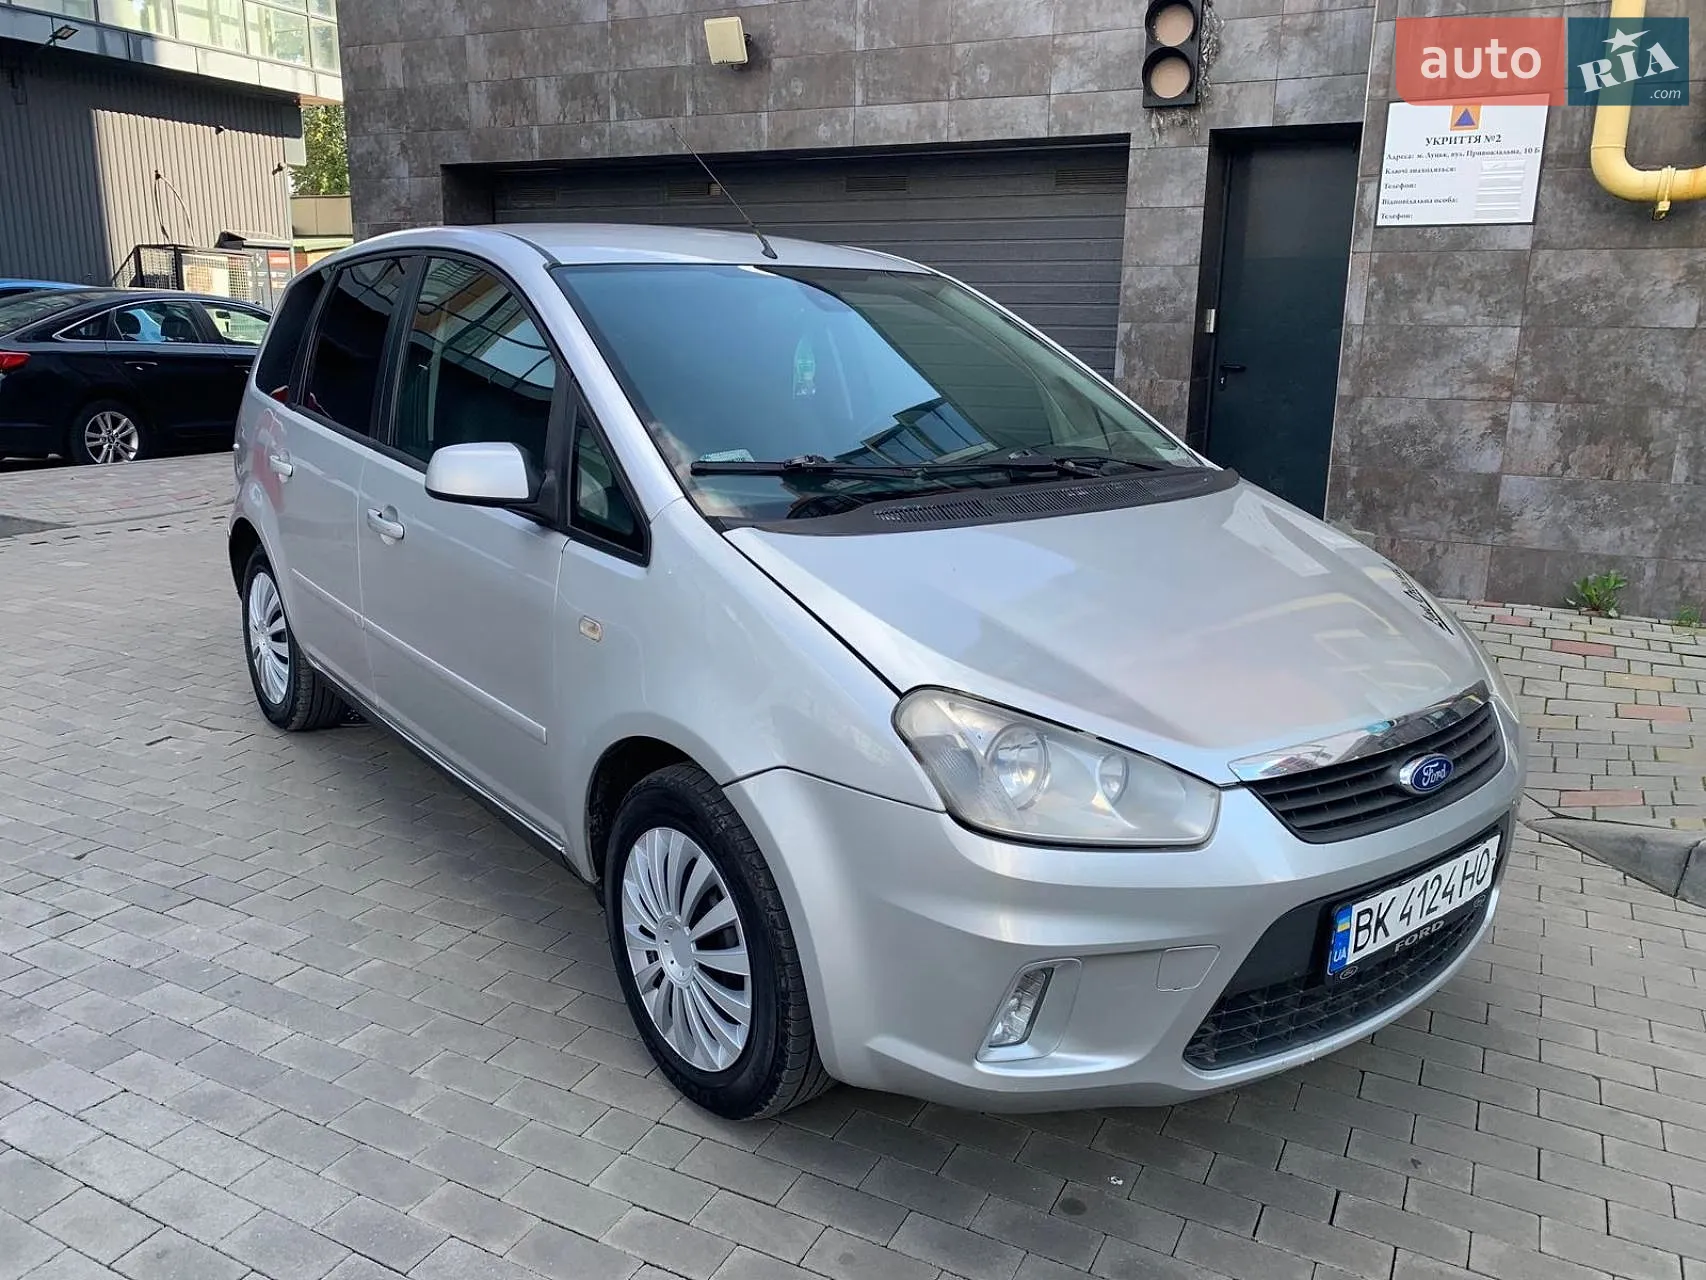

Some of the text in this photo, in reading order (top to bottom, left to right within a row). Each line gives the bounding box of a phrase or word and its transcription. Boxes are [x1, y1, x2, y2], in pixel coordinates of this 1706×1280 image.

[1425, 134, 1502, 146] УКРИТТЯ №2
[1421, 762, 1447, 787] Ford
[1353, 848, 1491, 954] BK 4124 HO
[1393, 920, 1445, 954] FORD
[1333, 946, 1347, 962] UA
